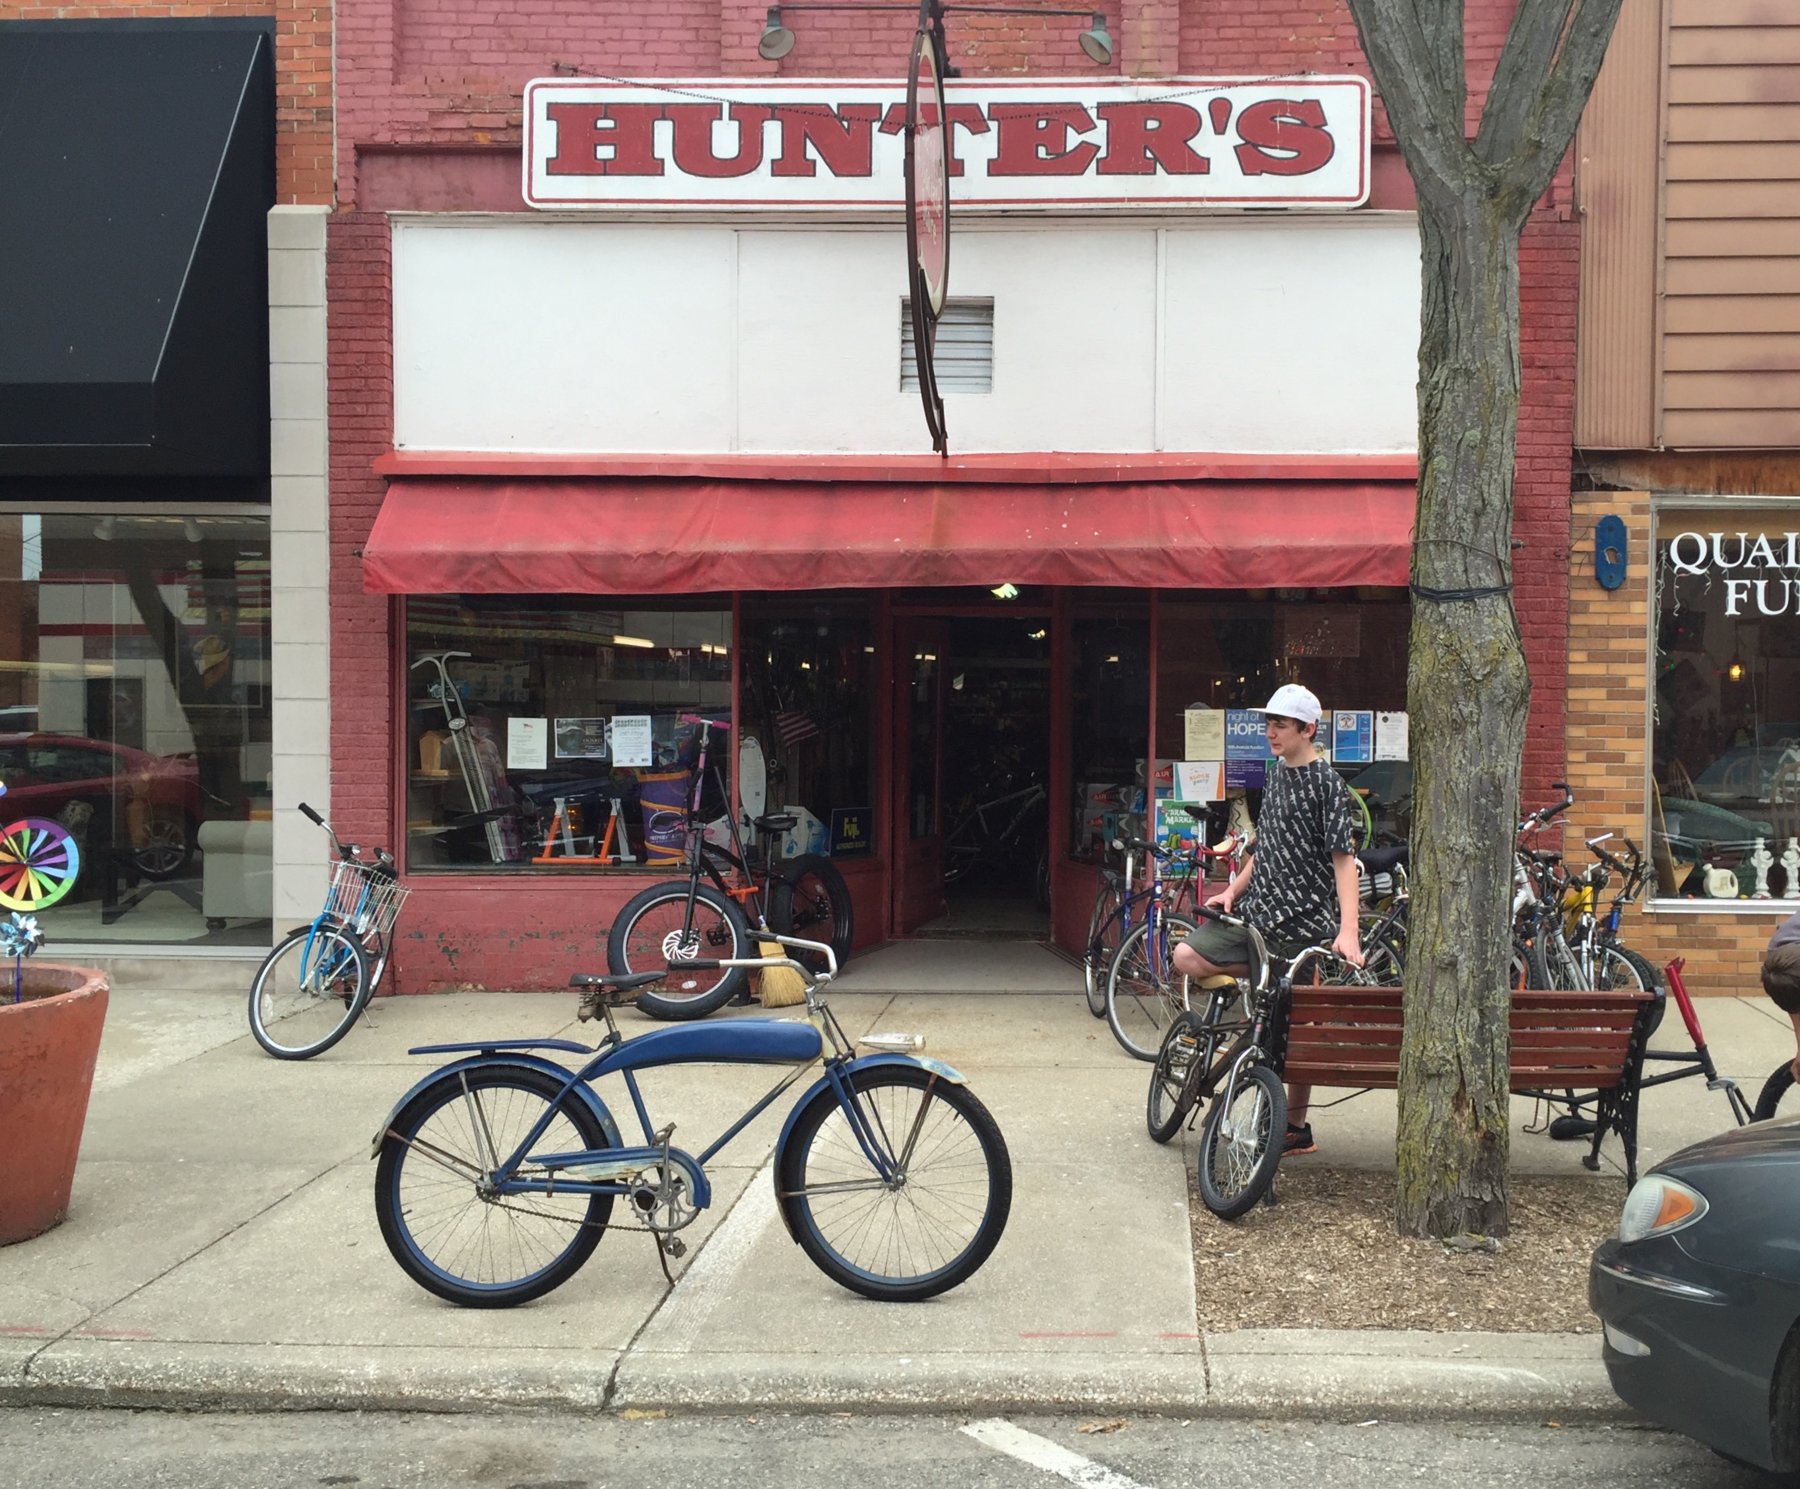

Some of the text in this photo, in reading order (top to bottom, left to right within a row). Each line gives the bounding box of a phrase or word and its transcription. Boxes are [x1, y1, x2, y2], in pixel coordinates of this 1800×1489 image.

[546, 98, 1335, 178] HUNTER'S
[1723, 579, 1800, 616] FU
[1227, 711, 1248, 722] night
[1227, 723, 1266, 736] HOPE
